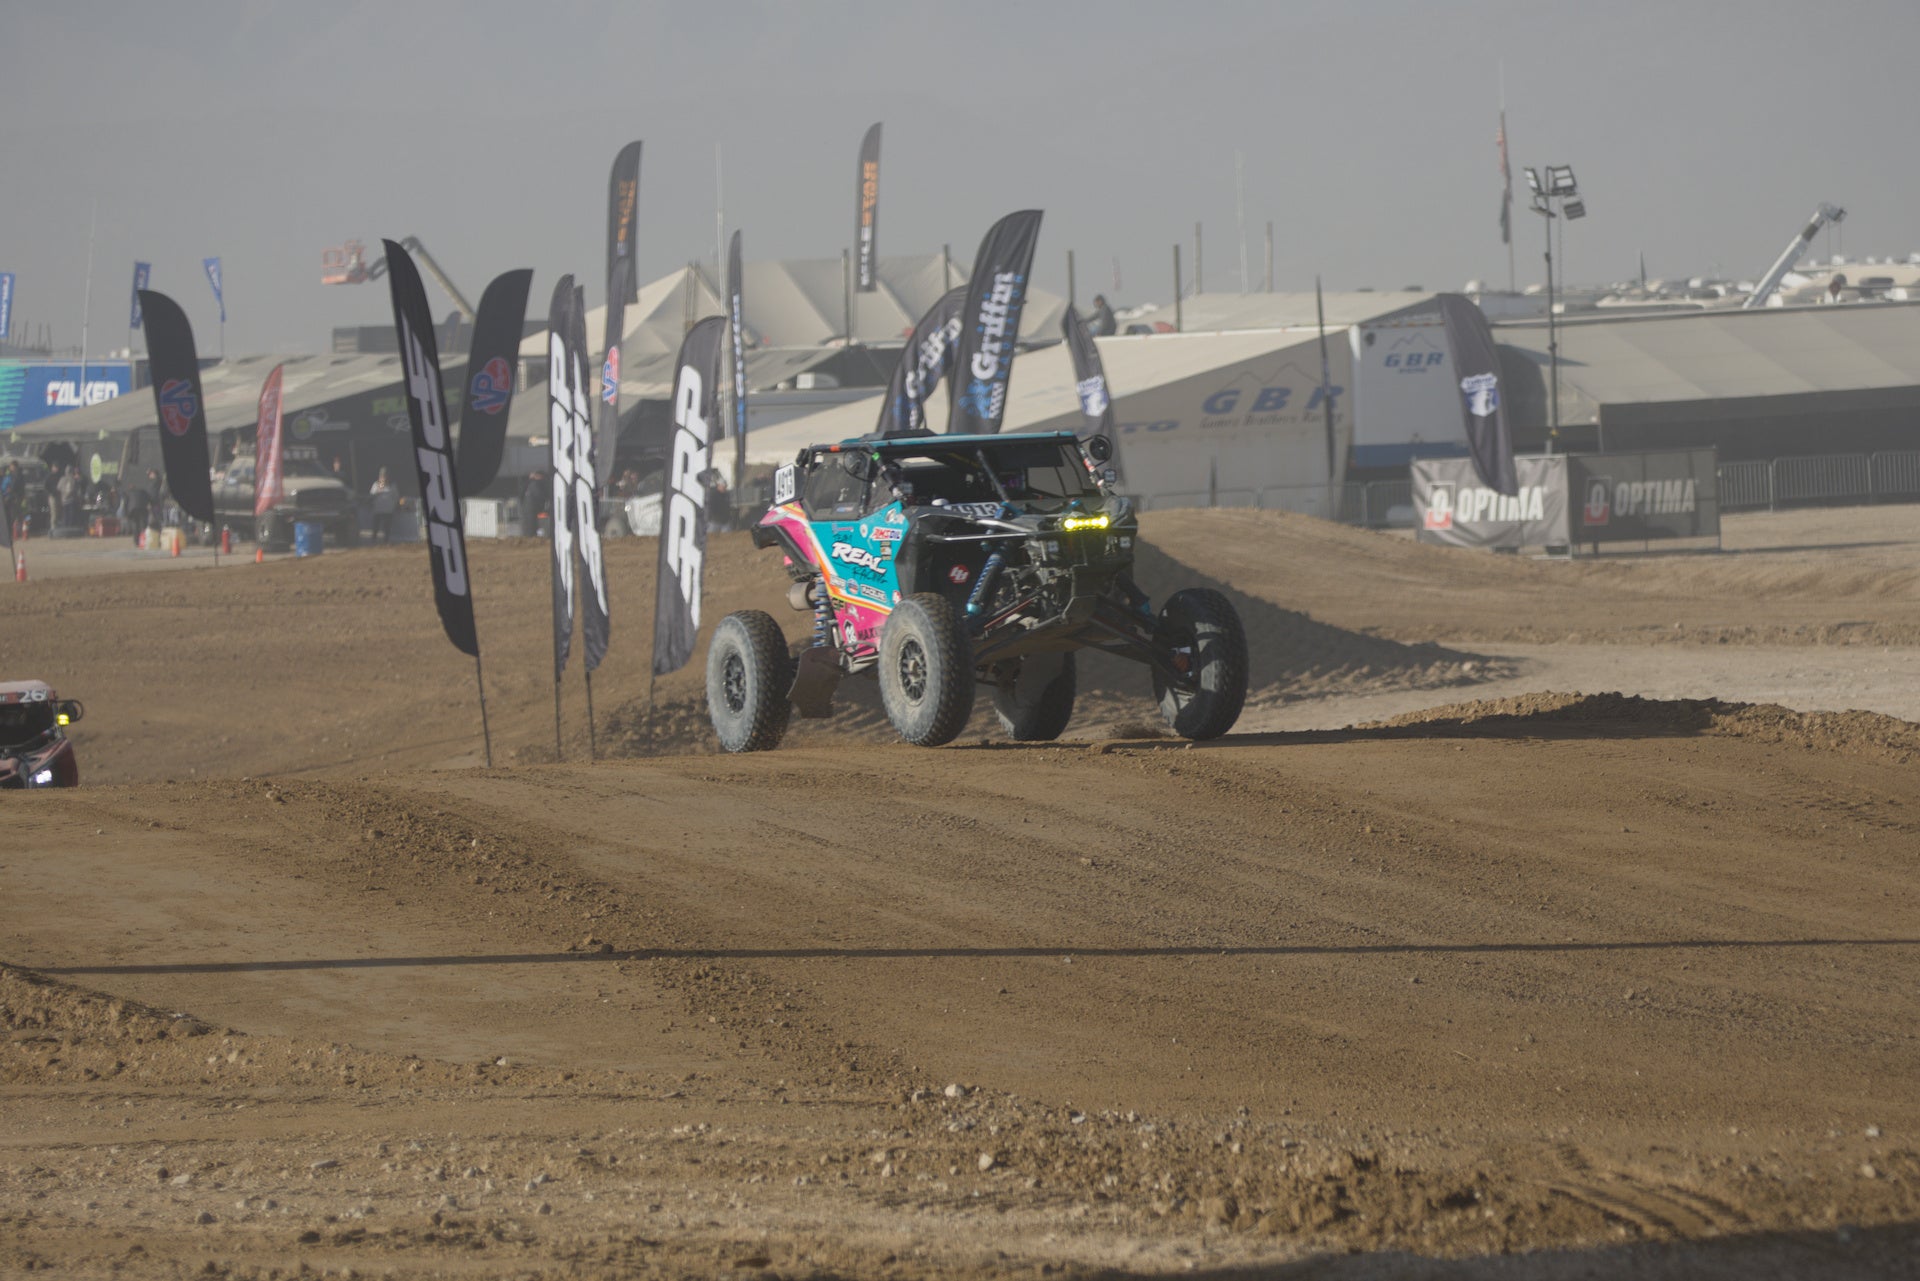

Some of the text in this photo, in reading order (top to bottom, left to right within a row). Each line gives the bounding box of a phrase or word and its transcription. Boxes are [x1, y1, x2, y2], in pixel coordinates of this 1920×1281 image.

[971, 272, 1014, 380] Griffin
[1384, 352, 1444, 367] GBR
[46, 381, 119, 407] FALKEN
[401, 308, 467, 597] PRP
[667, 364, 709, 631] PRP
[1614, 479, 1697, 516] OPTIMA
[831, 541, 887, 574] REAL
